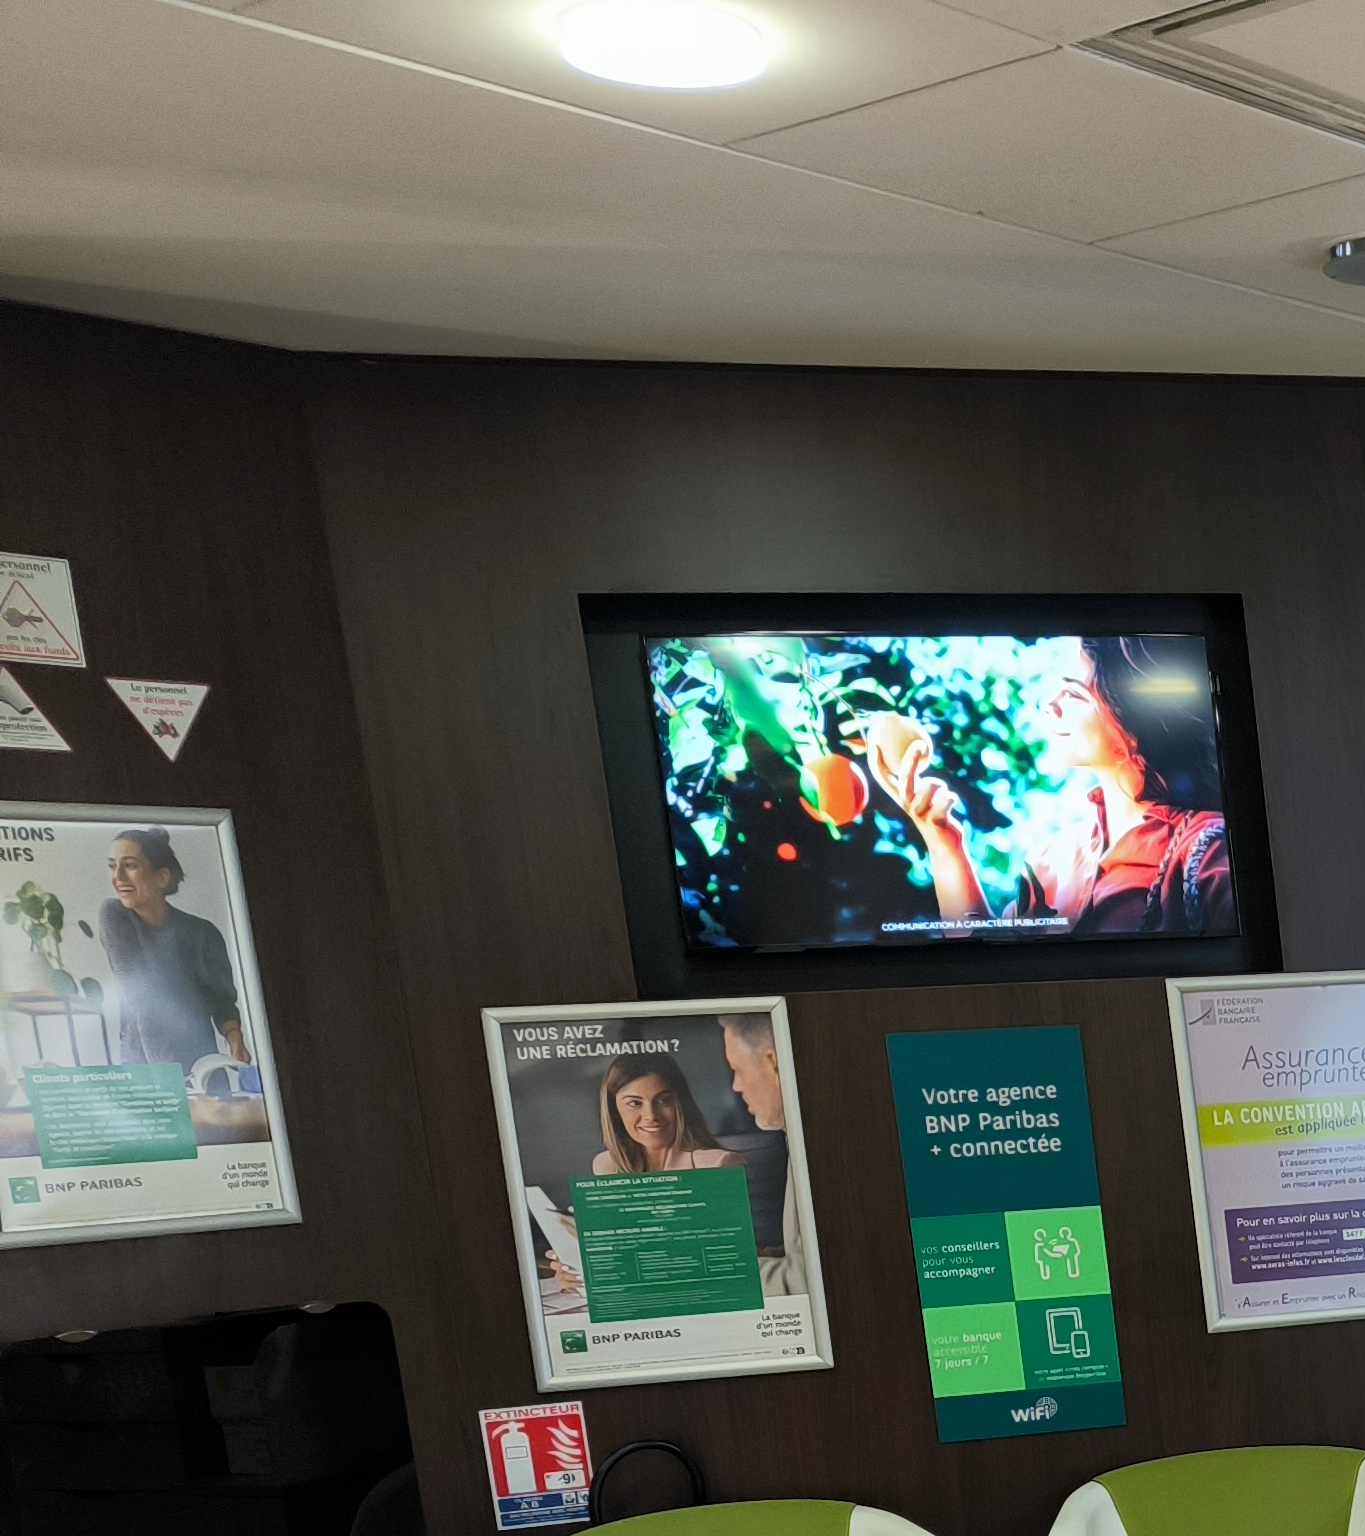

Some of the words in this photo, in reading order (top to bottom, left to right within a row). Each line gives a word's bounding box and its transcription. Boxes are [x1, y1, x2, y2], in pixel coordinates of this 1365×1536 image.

[0, 826, 55, 841] TIONS
[512, 1026, 558, 1042] VOUS
[563, 1025, 604, 1040] AVEZ
[516, 1046, 551, 1060] UNE
[556, 1039, 669, 1059] RÉCLAMATION
[32, 1074, 70, 1084] Clients
[921, 1087, 979, 1105] Votre
[986, 1084, 1057, 1107] agence
[925, 1113, 971, 1134] BNP
[978, 1109, 1060, 1131] Paribas
[1213, 1109, 1234, 1126] LA
[1240, 1101, 1345, 1124] CONVENTION
[1275, 1125, 1294, 1136] est
[1298, 1114, 1357, 1136] appliquée
[950, 1133, 1062, 1158] connectée
[226, 1162, 236, 1171] La
[237, 1161, 267, 1171] banque
[45, 1182, 75, 1194] BNP
[80, 1177, 143, 1191] PARIBAS
[1236, 1217, 1260, 1228] Pour
[1262, 1217, 1275, 1226] en
[1277, 1213, 1307, 1224] savoir
[1309, 1212, 1330, 1224] plus
[1332, 1211, 1349, 1220] sur
[1351, 1208, 1360, 1219] la
[921, 1246, 939, 1254] vos
[942, 1240, 1000, 1253] conseillers
[922, 1258, 946, 1269] pour
[949, 1256, 974, 1265] vous
[924, 1266, 996, 1279] accompagner
[761, 1313, 771, 1321] La
[592, 1333, 620, 1346] BNP
[624, 1328, 682, 1342] PARIBAS
[963, 1331, 1002, 1343] banque
[945, 1358, 972, 1370] jours
[484, 1404, 580, 1420] EXTINCTEUR
[1011, 1403, 1050, 1423] WiFi
